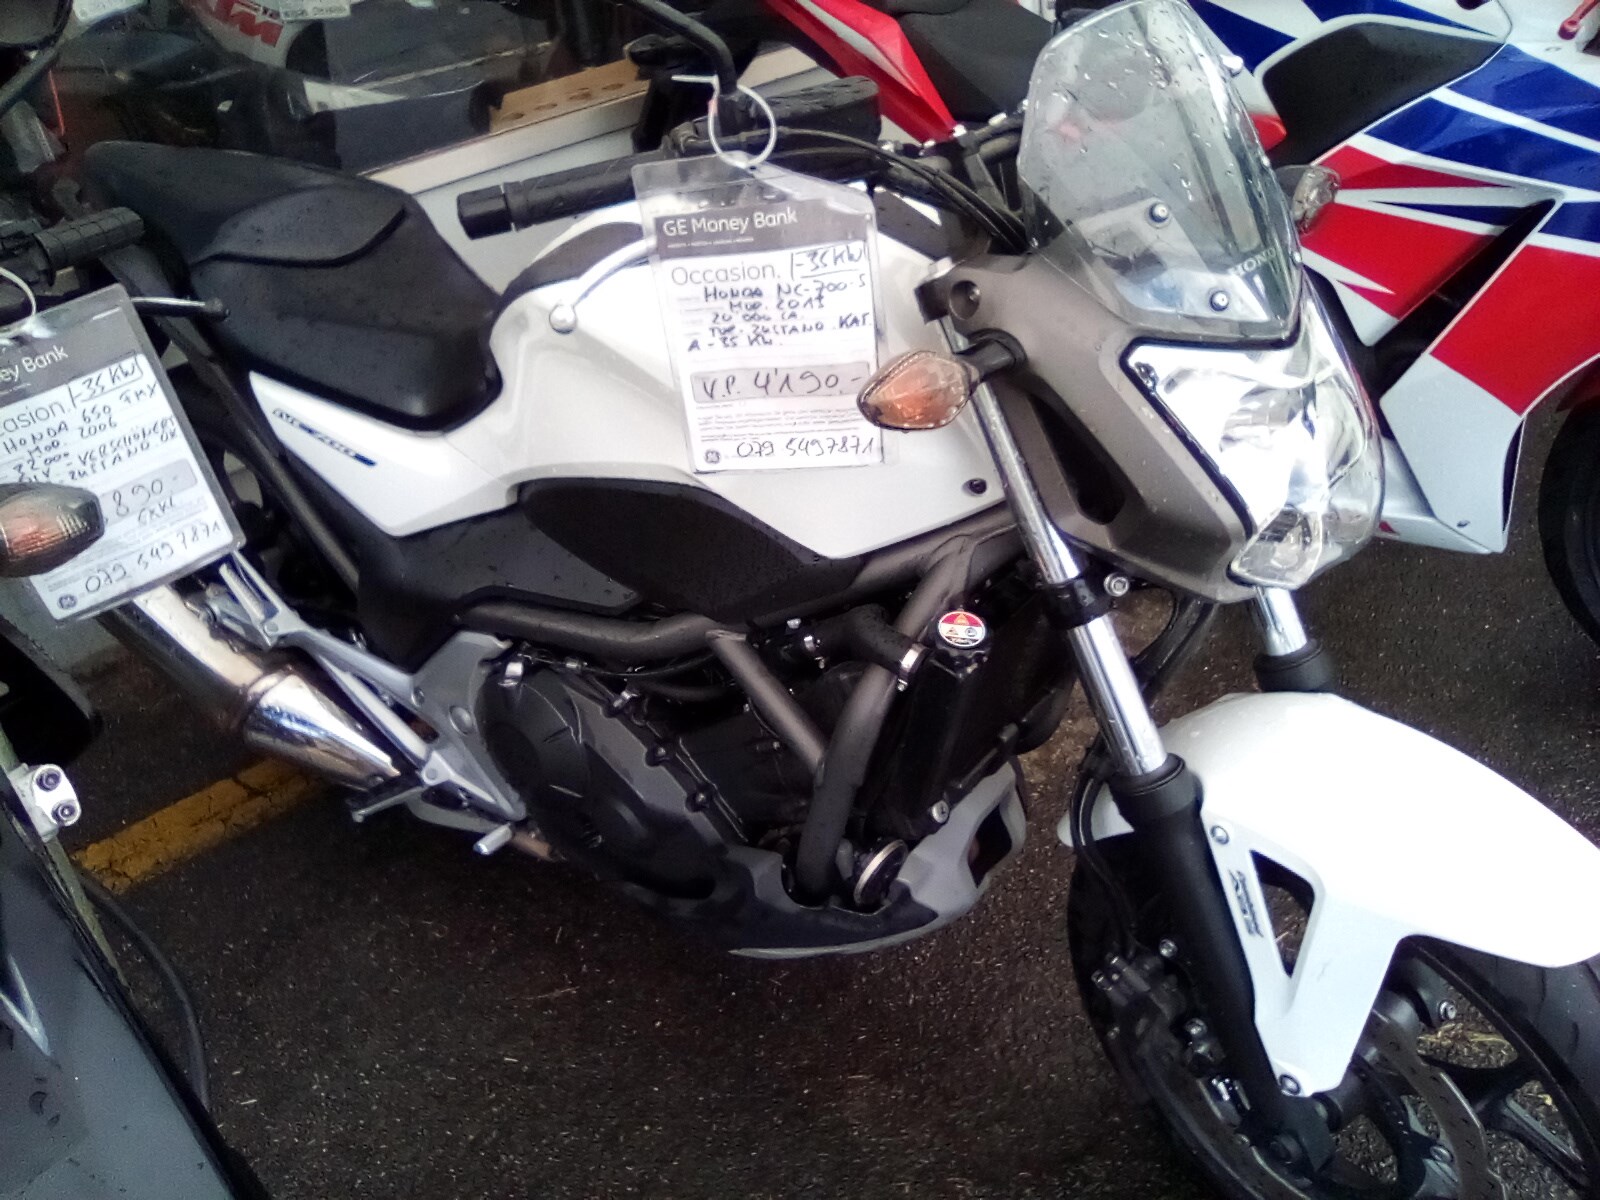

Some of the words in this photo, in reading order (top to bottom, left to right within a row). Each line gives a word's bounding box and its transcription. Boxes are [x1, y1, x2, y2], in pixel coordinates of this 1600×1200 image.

[662, 218, 689, 237] GE
[691, 215, 750, 235] Money
[753, 206, 799, 229] Bank
[704, 286, 763, 303] HONDA
[21, 344, 69, 373] Bank
[2, 420, 70, 455] HONDA
[78, 416, 118, 440] 2006
[736, 440, 774, 458] 079
